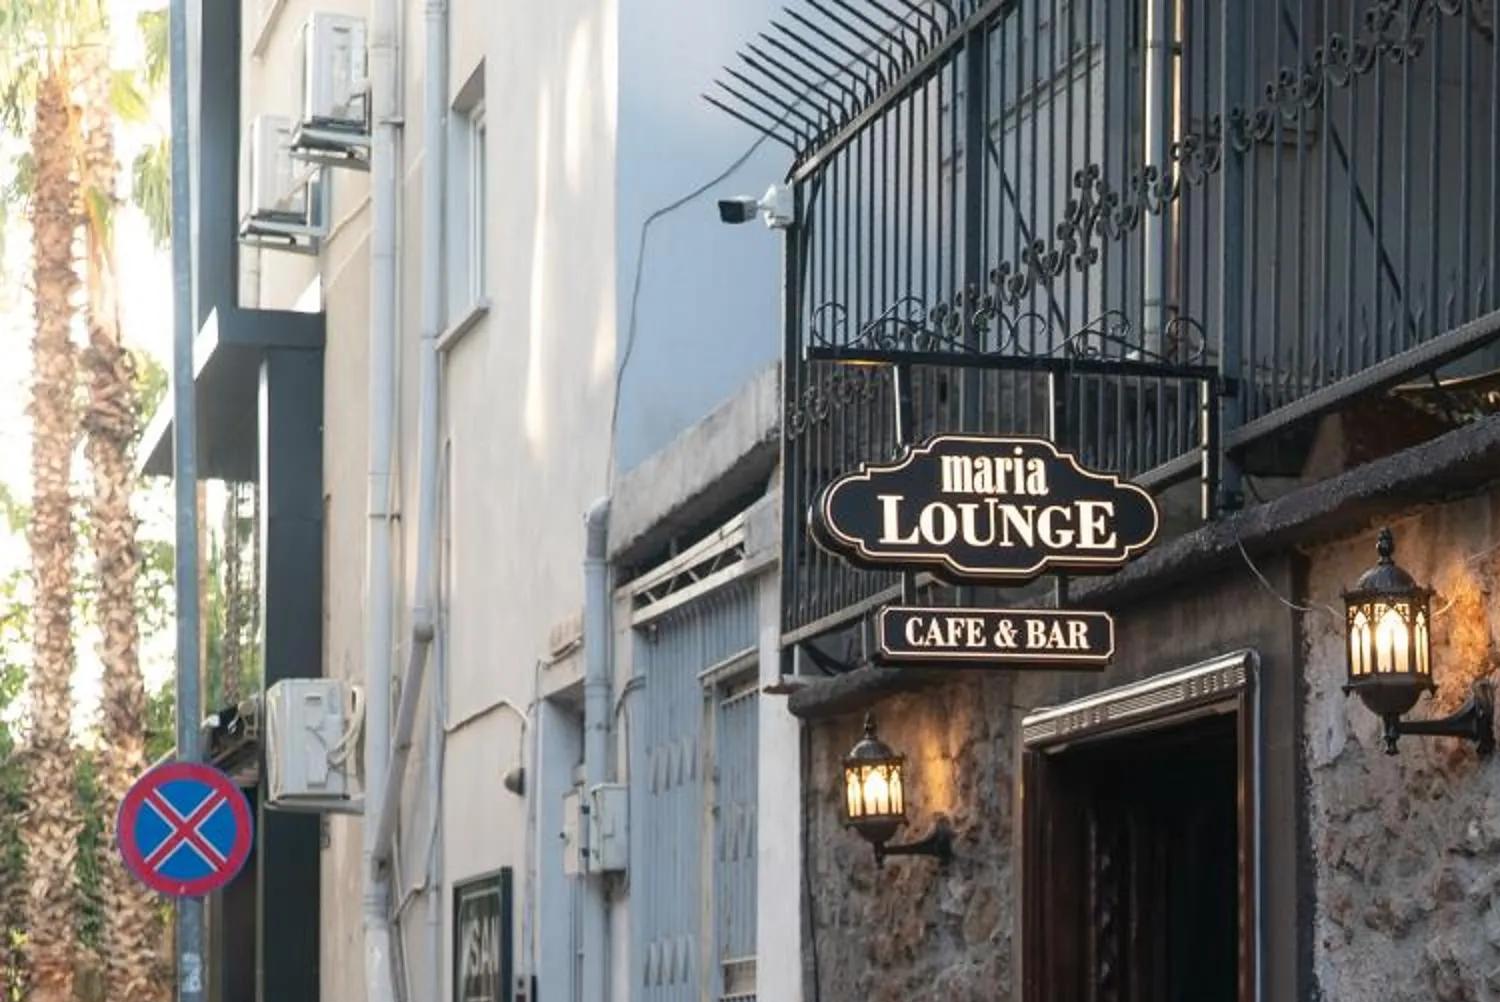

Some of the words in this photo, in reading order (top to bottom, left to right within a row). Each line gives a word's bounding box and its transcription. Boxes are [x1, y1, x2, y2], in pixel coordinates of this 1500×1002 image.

[941, 447, 1048, 495] maria
[877, 495, 1117, 549] LOUNGE
[905, 617, 985, 647] CAFE
[993, 618, 1018, 648] &
[1025, 620, 1090, 649] BAR
